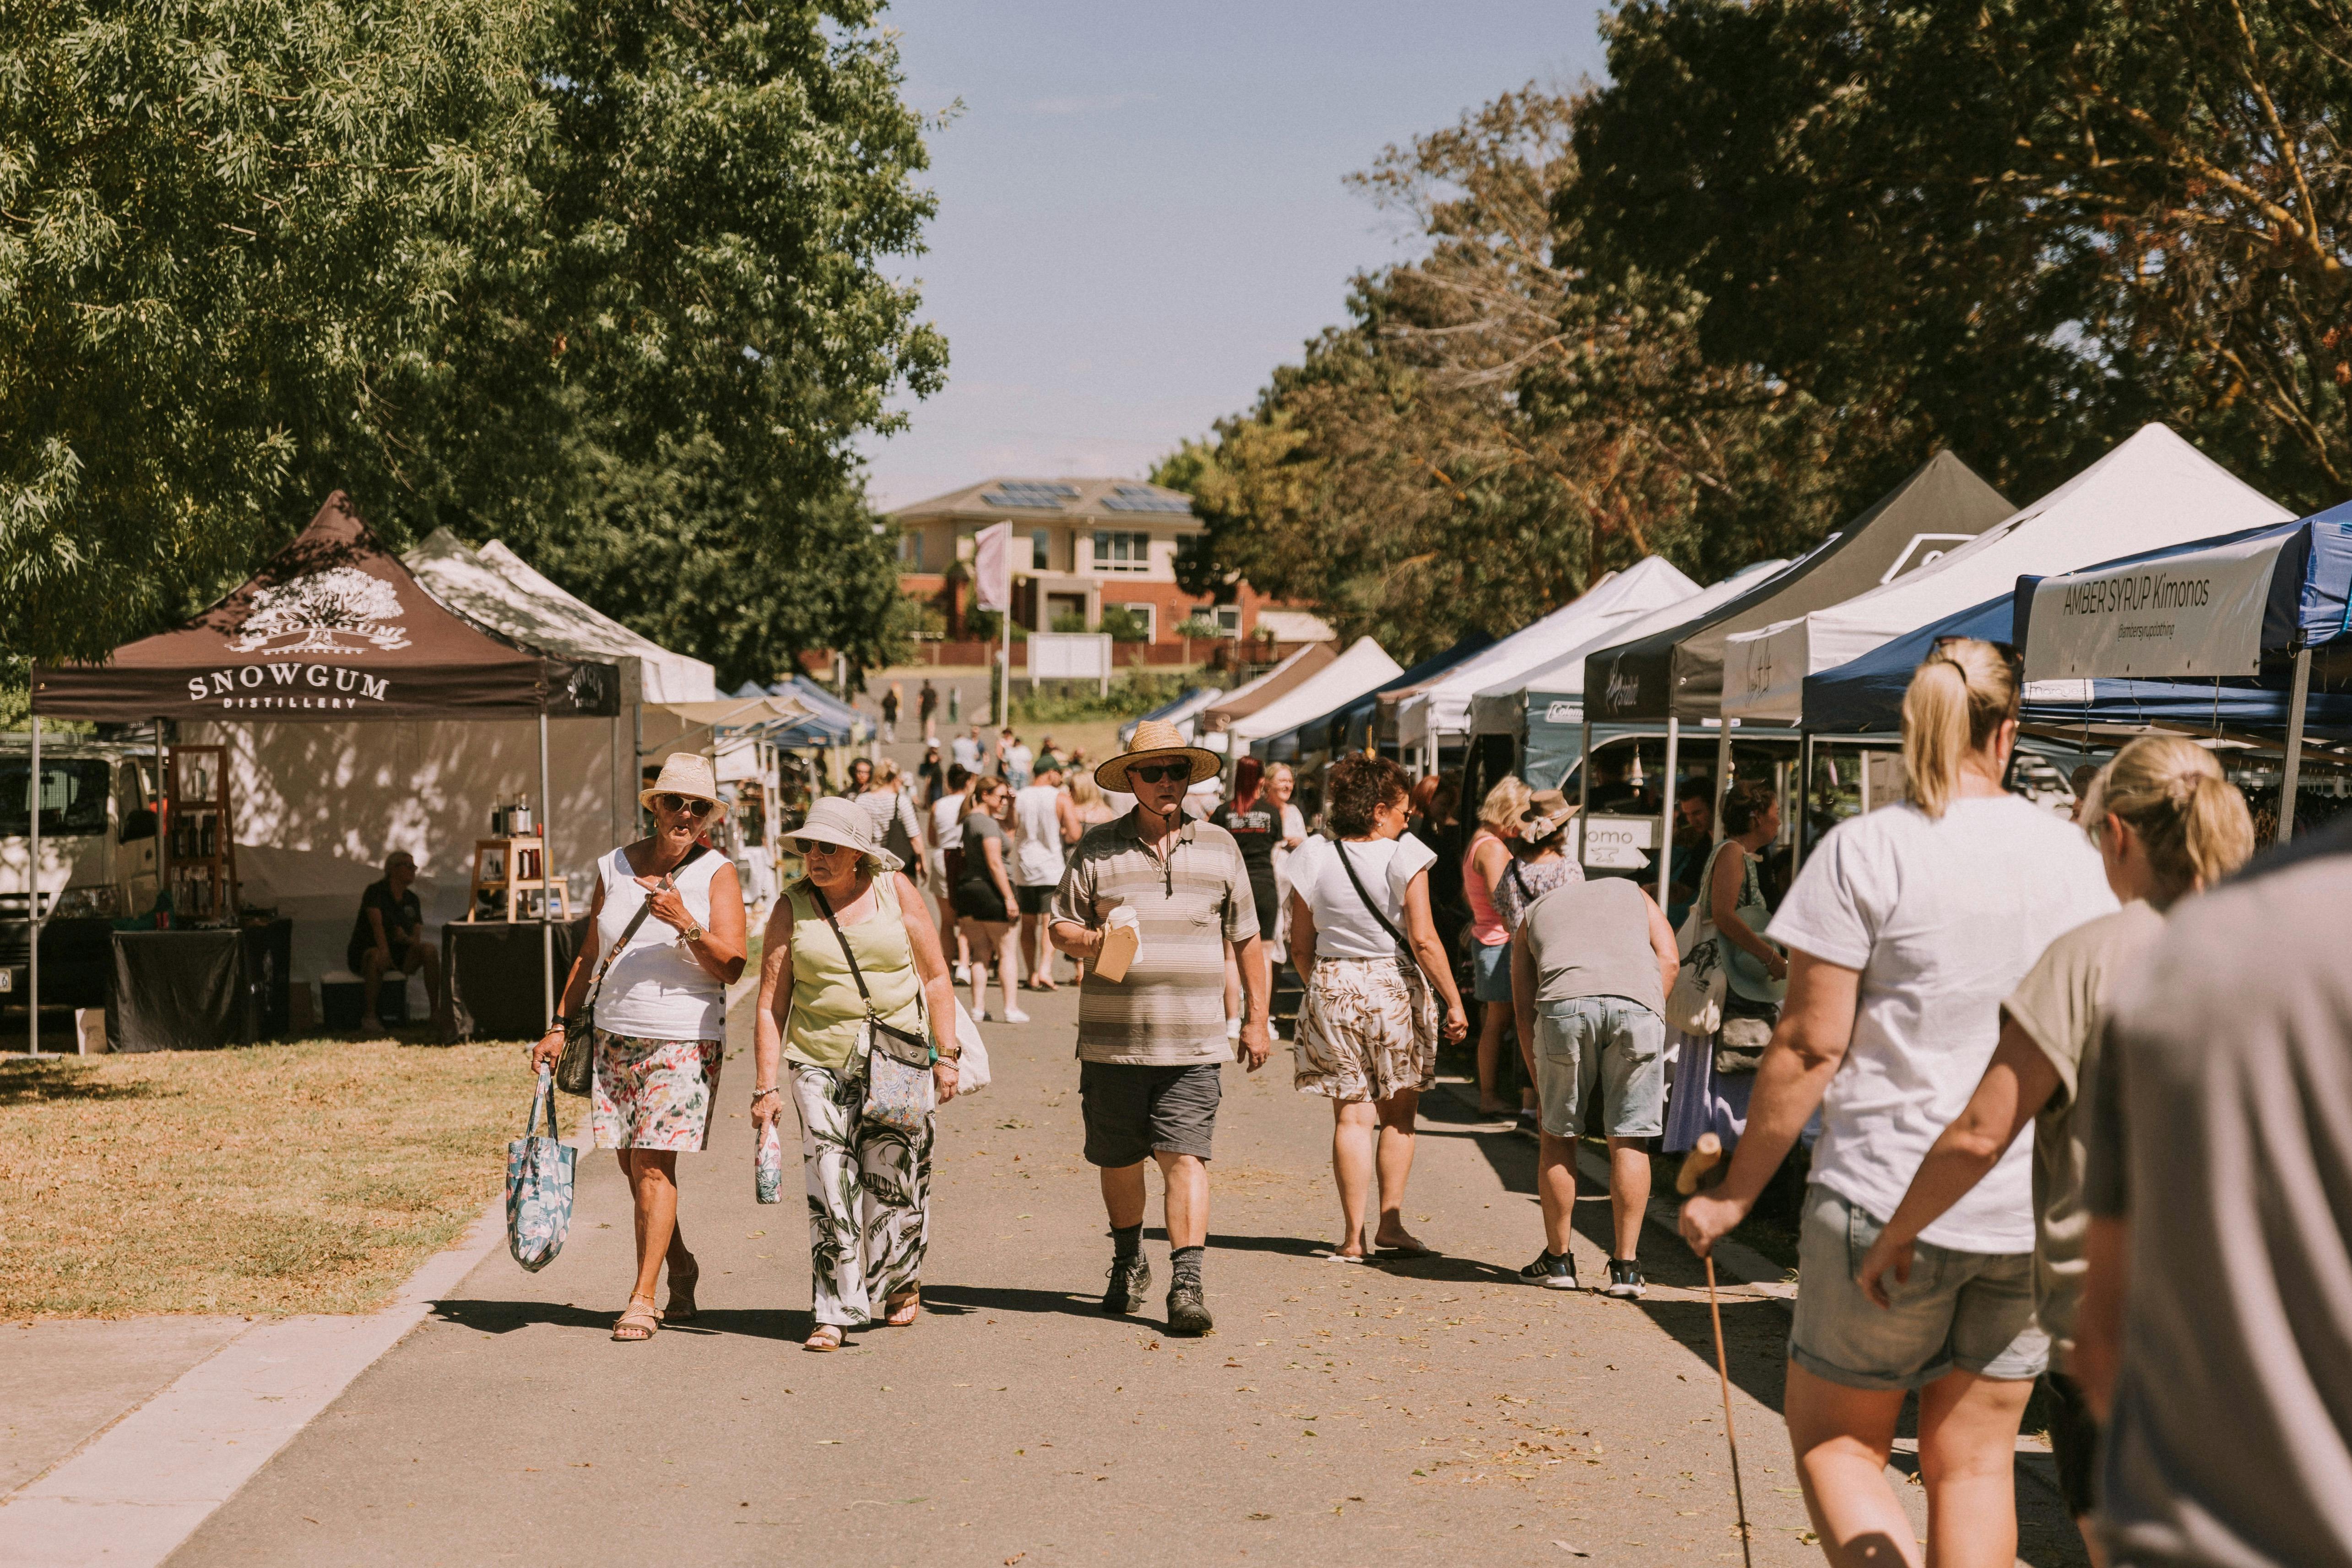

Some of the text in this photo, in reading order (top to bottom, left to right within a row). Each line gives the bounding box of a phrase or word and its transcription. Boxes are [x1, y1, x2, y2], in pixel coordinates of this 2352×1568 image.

[2064, 572, 2210, 616] AMBER SYRUP Kimonos
[188, 662, 390, 701] SNOWGUM
[223, 697, 356, 709] DISTILLERY
